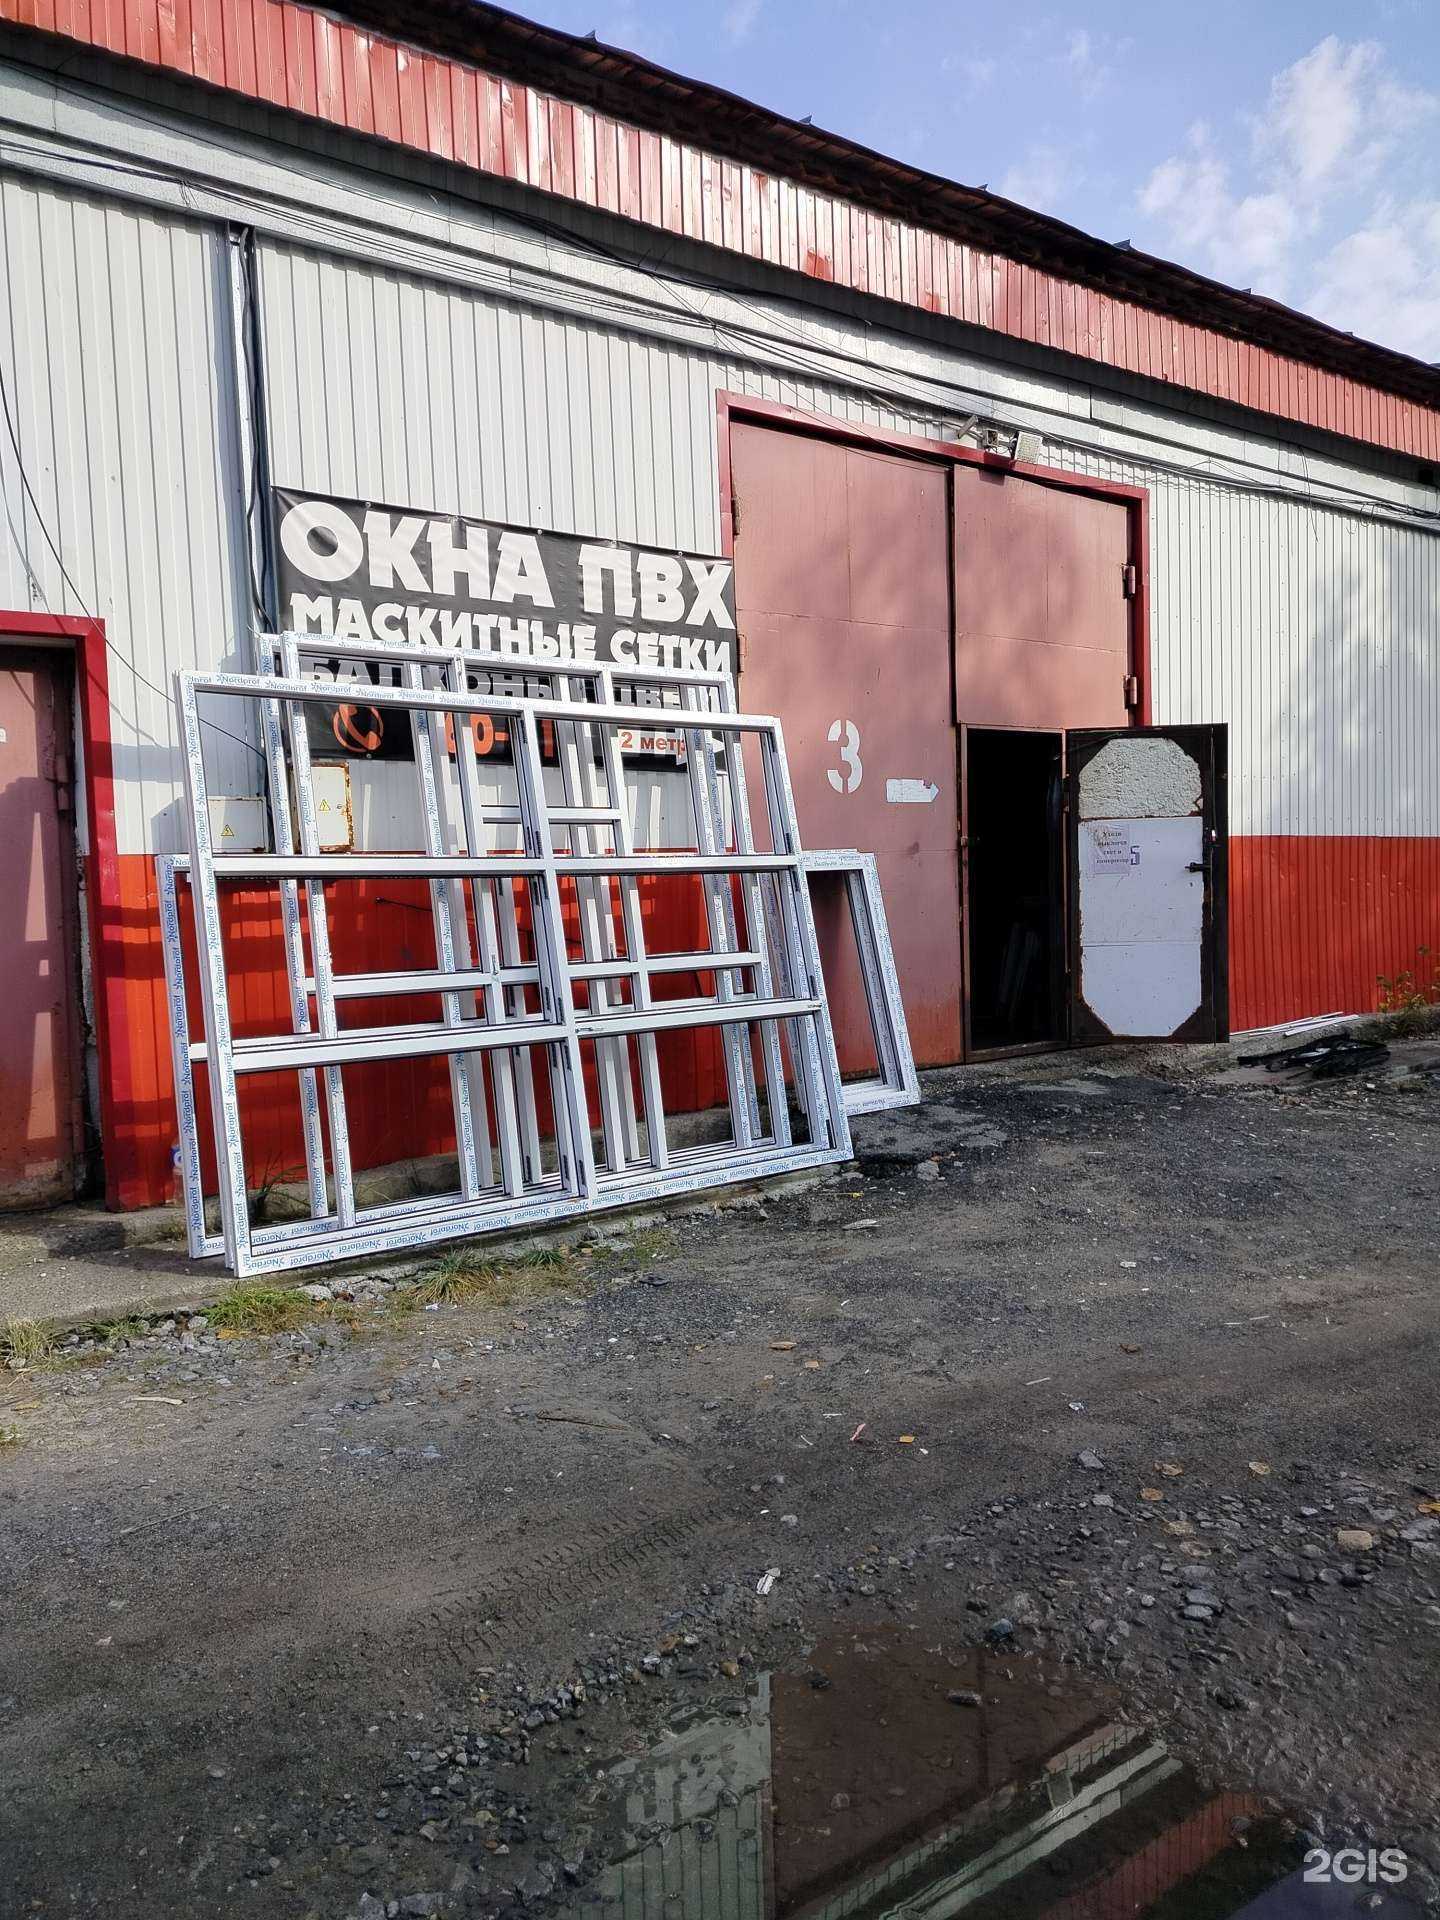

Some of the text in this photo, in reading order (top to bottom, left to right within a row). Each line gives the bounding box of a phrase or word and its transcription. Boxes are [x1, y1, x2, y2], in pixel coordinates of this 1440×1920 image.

[280, 501, 736, 629] ОКНА ПВХ
[289, 593, 597, 661] МАСКИТНЫЕ
[609, 629, 730, 673] СЕТКИ
[186, 714, 197, 752] Nordprof
[621, 731, 633, 749] 2
[640, 736, 686, 756] метр
[827, 719, 863, 794] 3
[196, 811, 206, 849] Nordprof
[165, 901, 177, 938] Nordprof
[205, 906, 217, 944] Nordprof
[174, 995, 185, 1032] Nordprof
[226, 1103, 237, 1142] Nordprof
[190, 1188, 201, 1225] Nordprof
[234, 1204, 246, 1243] Nordprof
[290, 1250, 330, 1265] Nordprof
[386, 1232, 422, 1247] Nordprof
